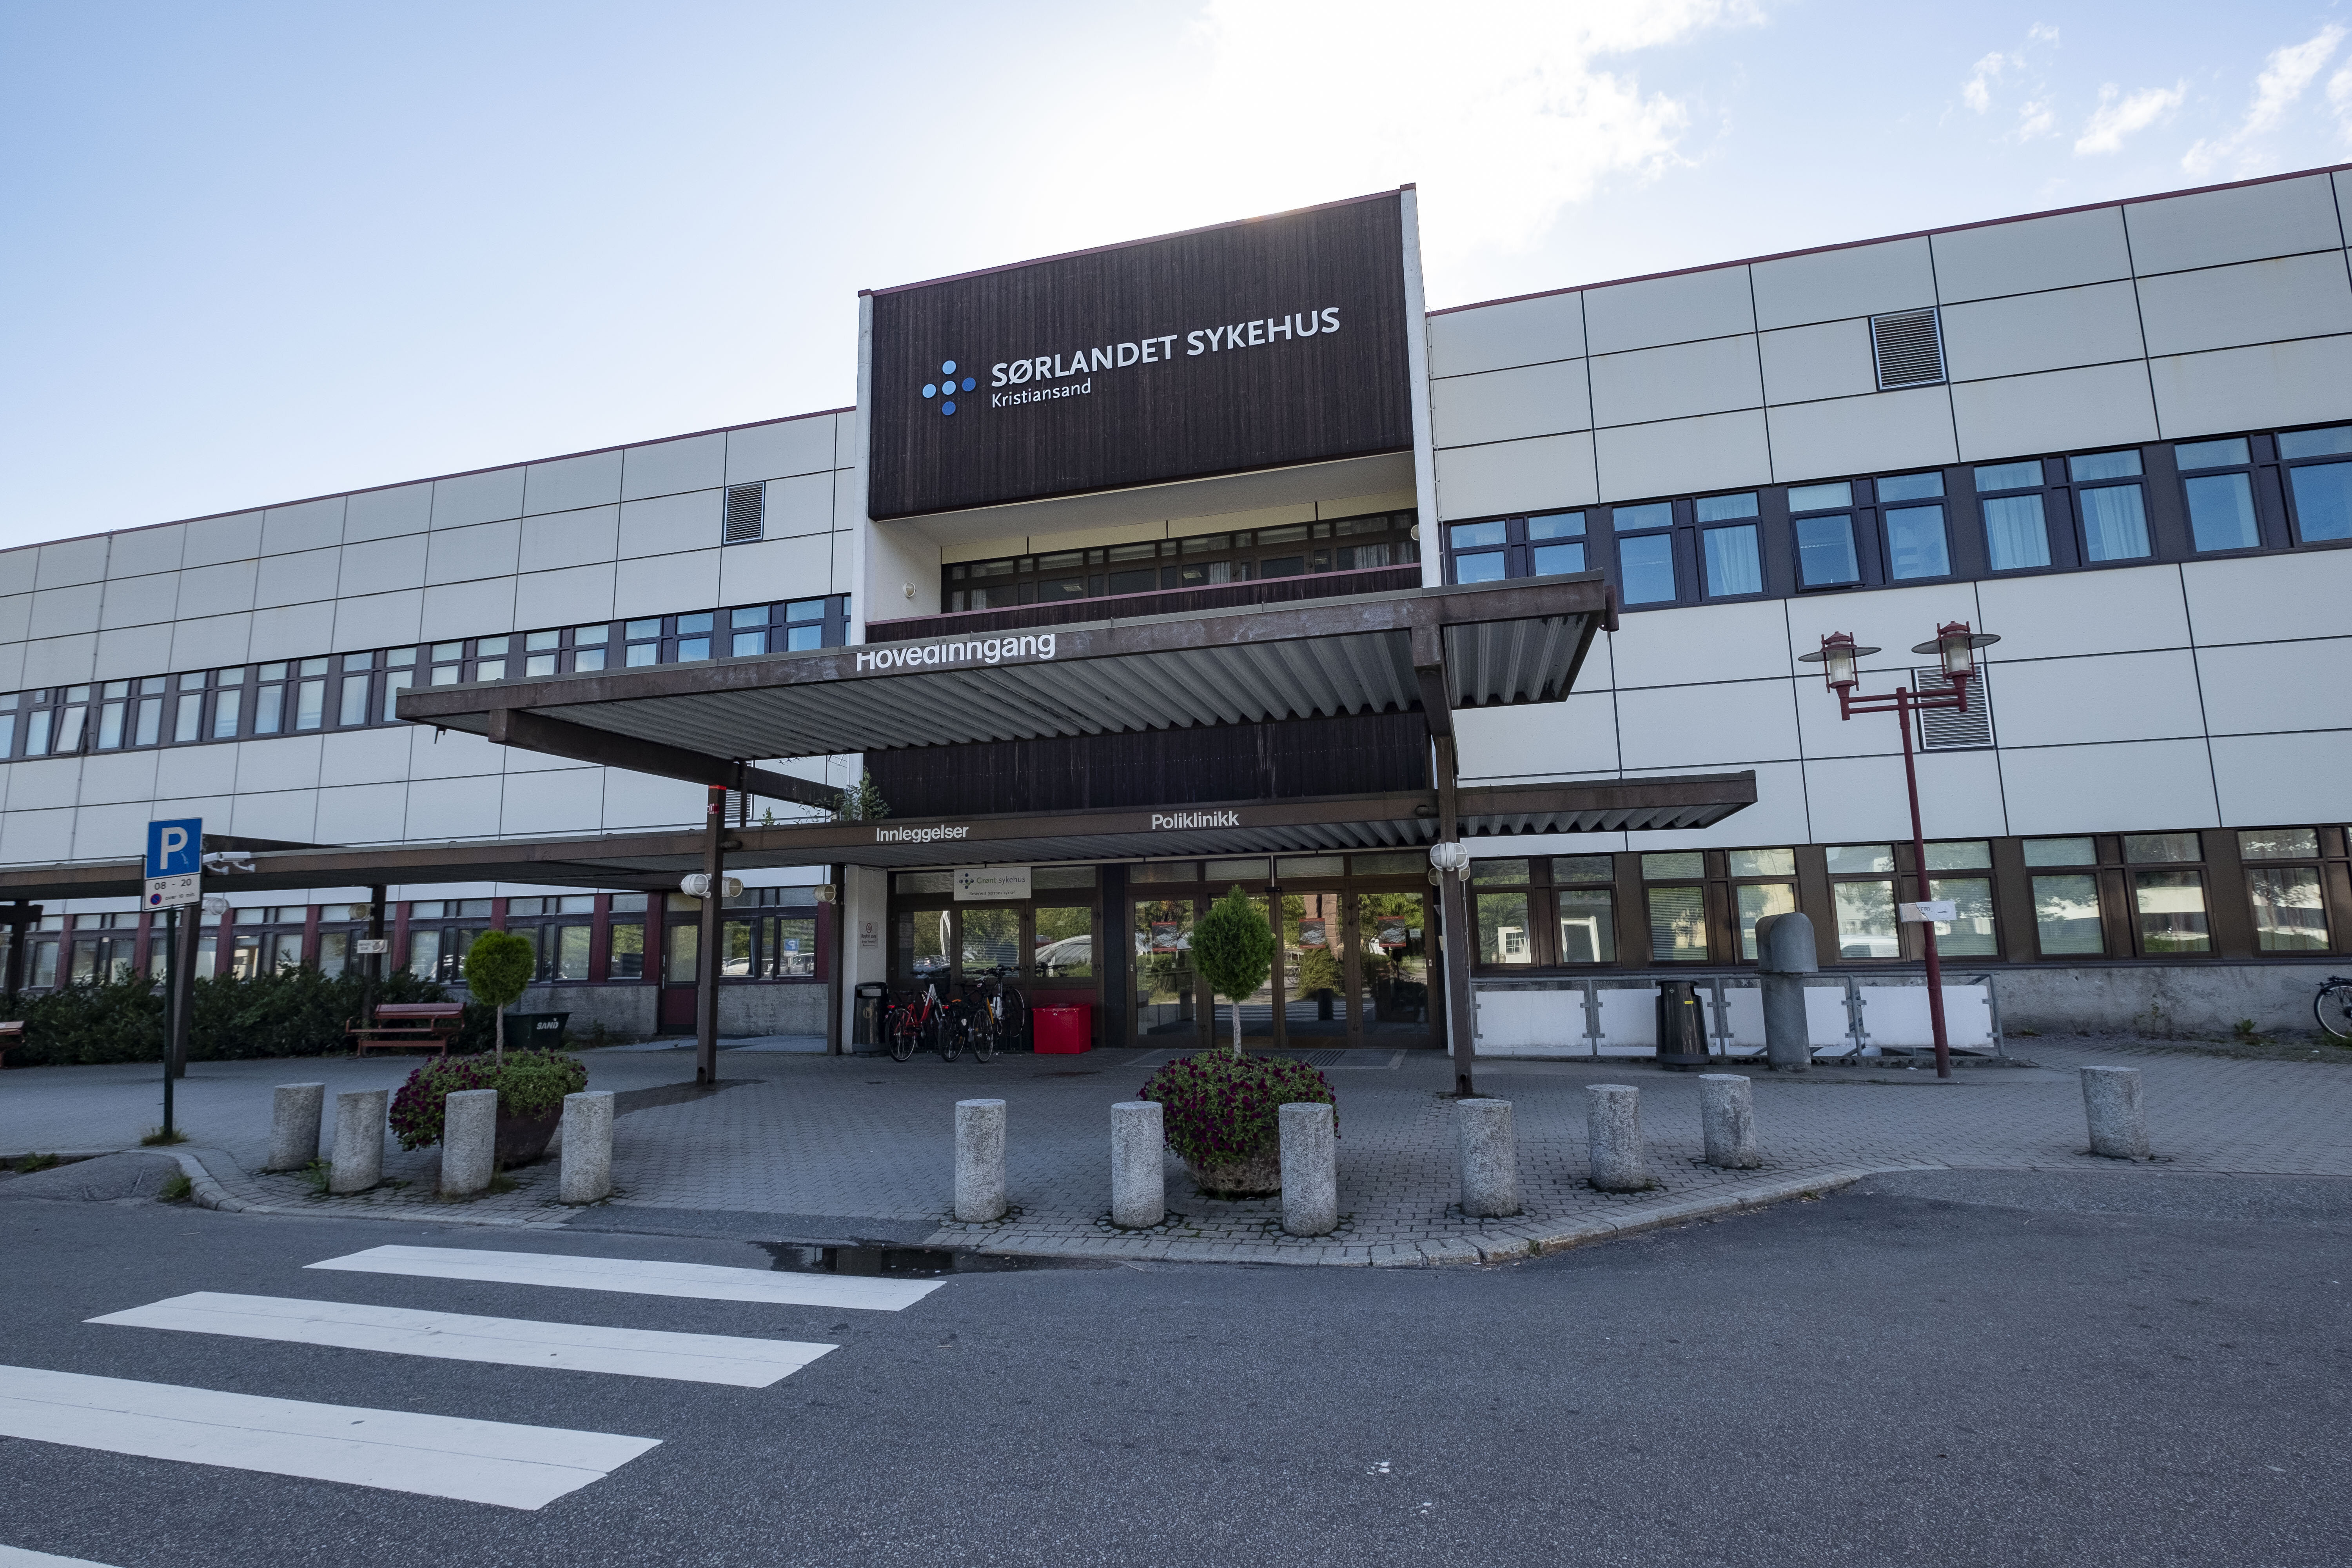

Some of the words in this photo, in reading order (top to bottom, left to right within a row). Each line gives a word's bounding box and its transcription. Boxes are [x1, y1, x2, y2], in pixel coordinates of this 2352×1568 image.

[991, 334, 1177, 387] SØRLANDET
[1187, 307, 1340, 356] SYKEHUS
[992, 377, 1091, 408] Kristiansand
[857, 633, 1055, 671] Hovedinngang
[1152, 811, 1240, 829] Poliklinikk
[876, 824, 969, 843] Innleggelser
[160, 827, 188, 870] P
[154, 882, 166, 890] 08
[181, 878, 192, 887] 20
[998, 875, 1025, 885] sykehus
[536, 1022, 559, 1030] SAND
